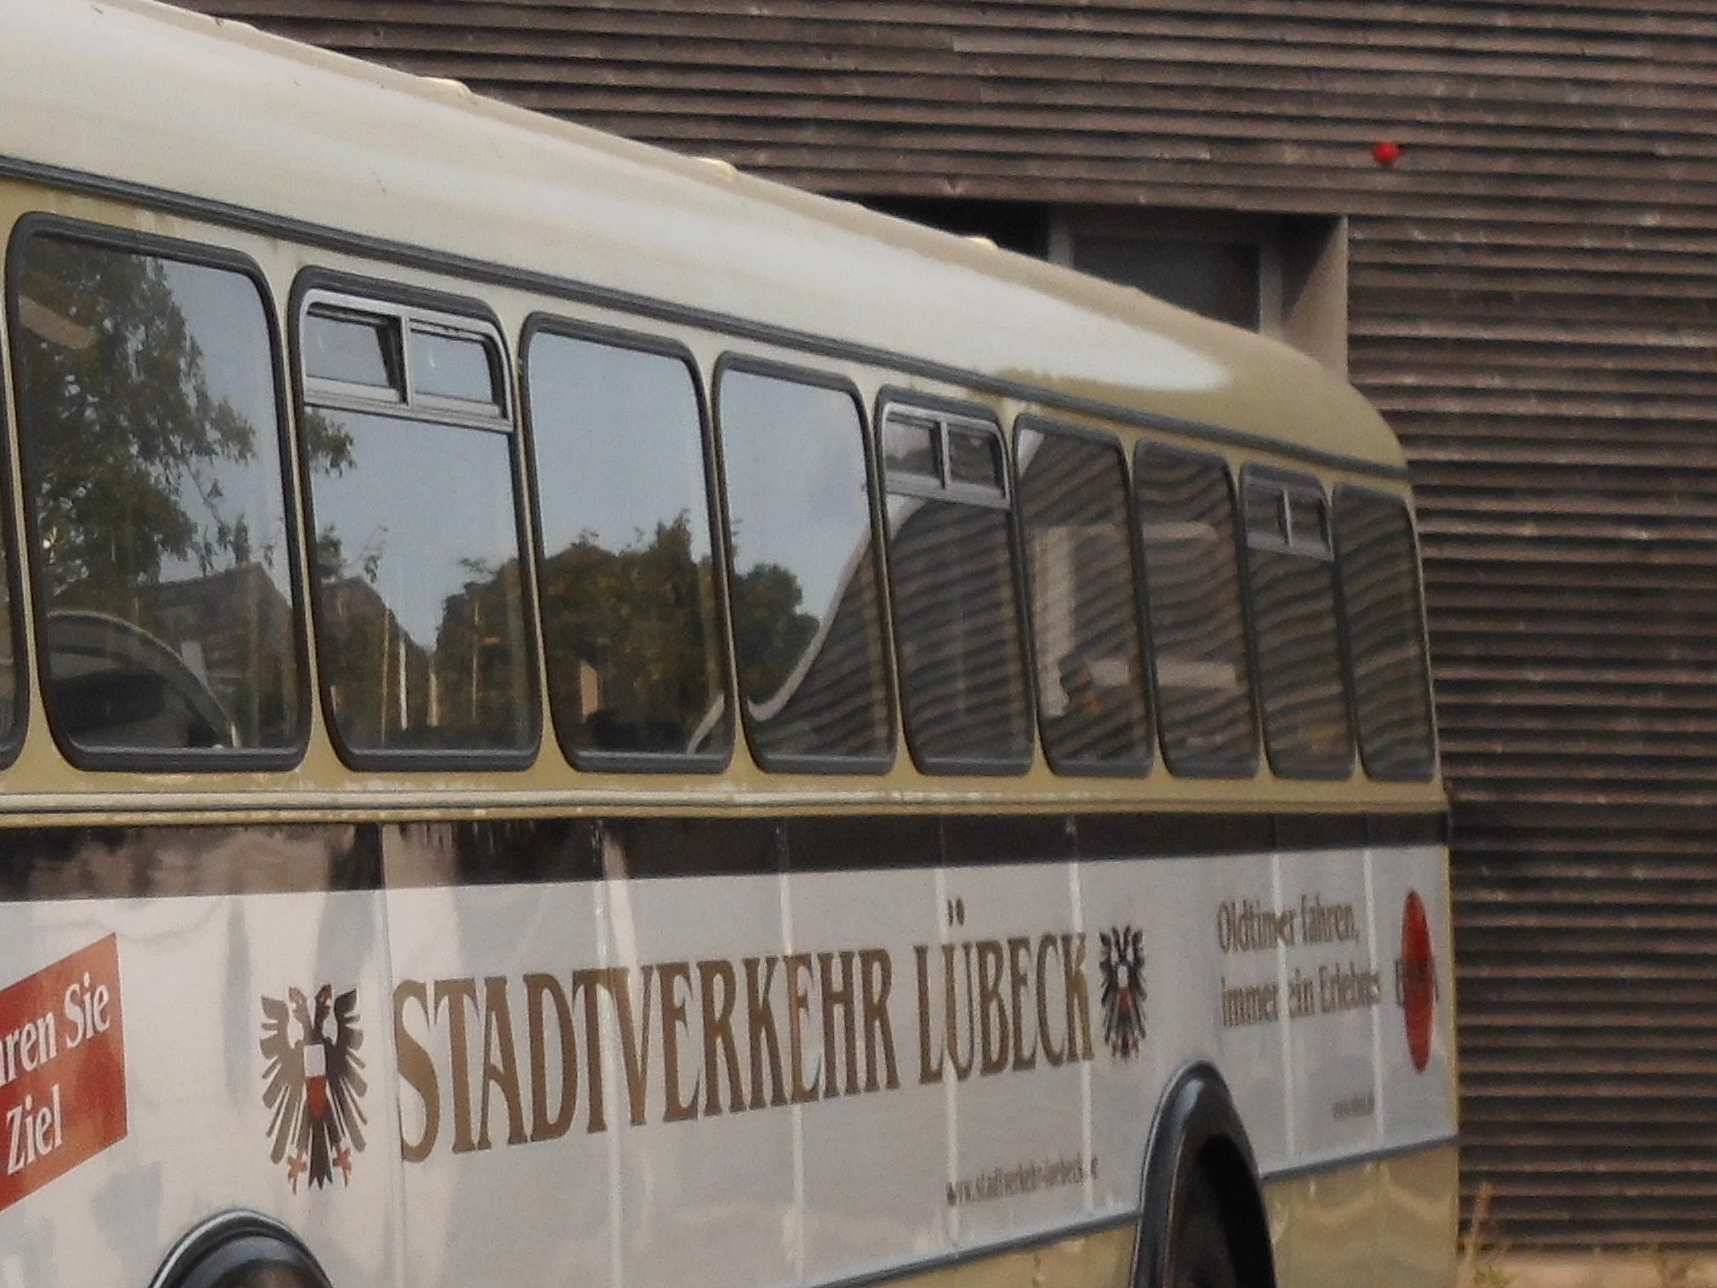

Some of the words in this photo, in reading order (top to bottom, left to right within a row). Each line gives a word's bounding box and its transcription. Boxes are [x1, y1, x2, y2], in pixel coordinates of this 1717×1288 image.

[63, 973, 111, 1051] Sie
[393, 947, 901, 1163] STADTVERKEHR
[913, 898, 1095, 1085] LÜBECK
[6, 1084, 64, 1178] Ziel
